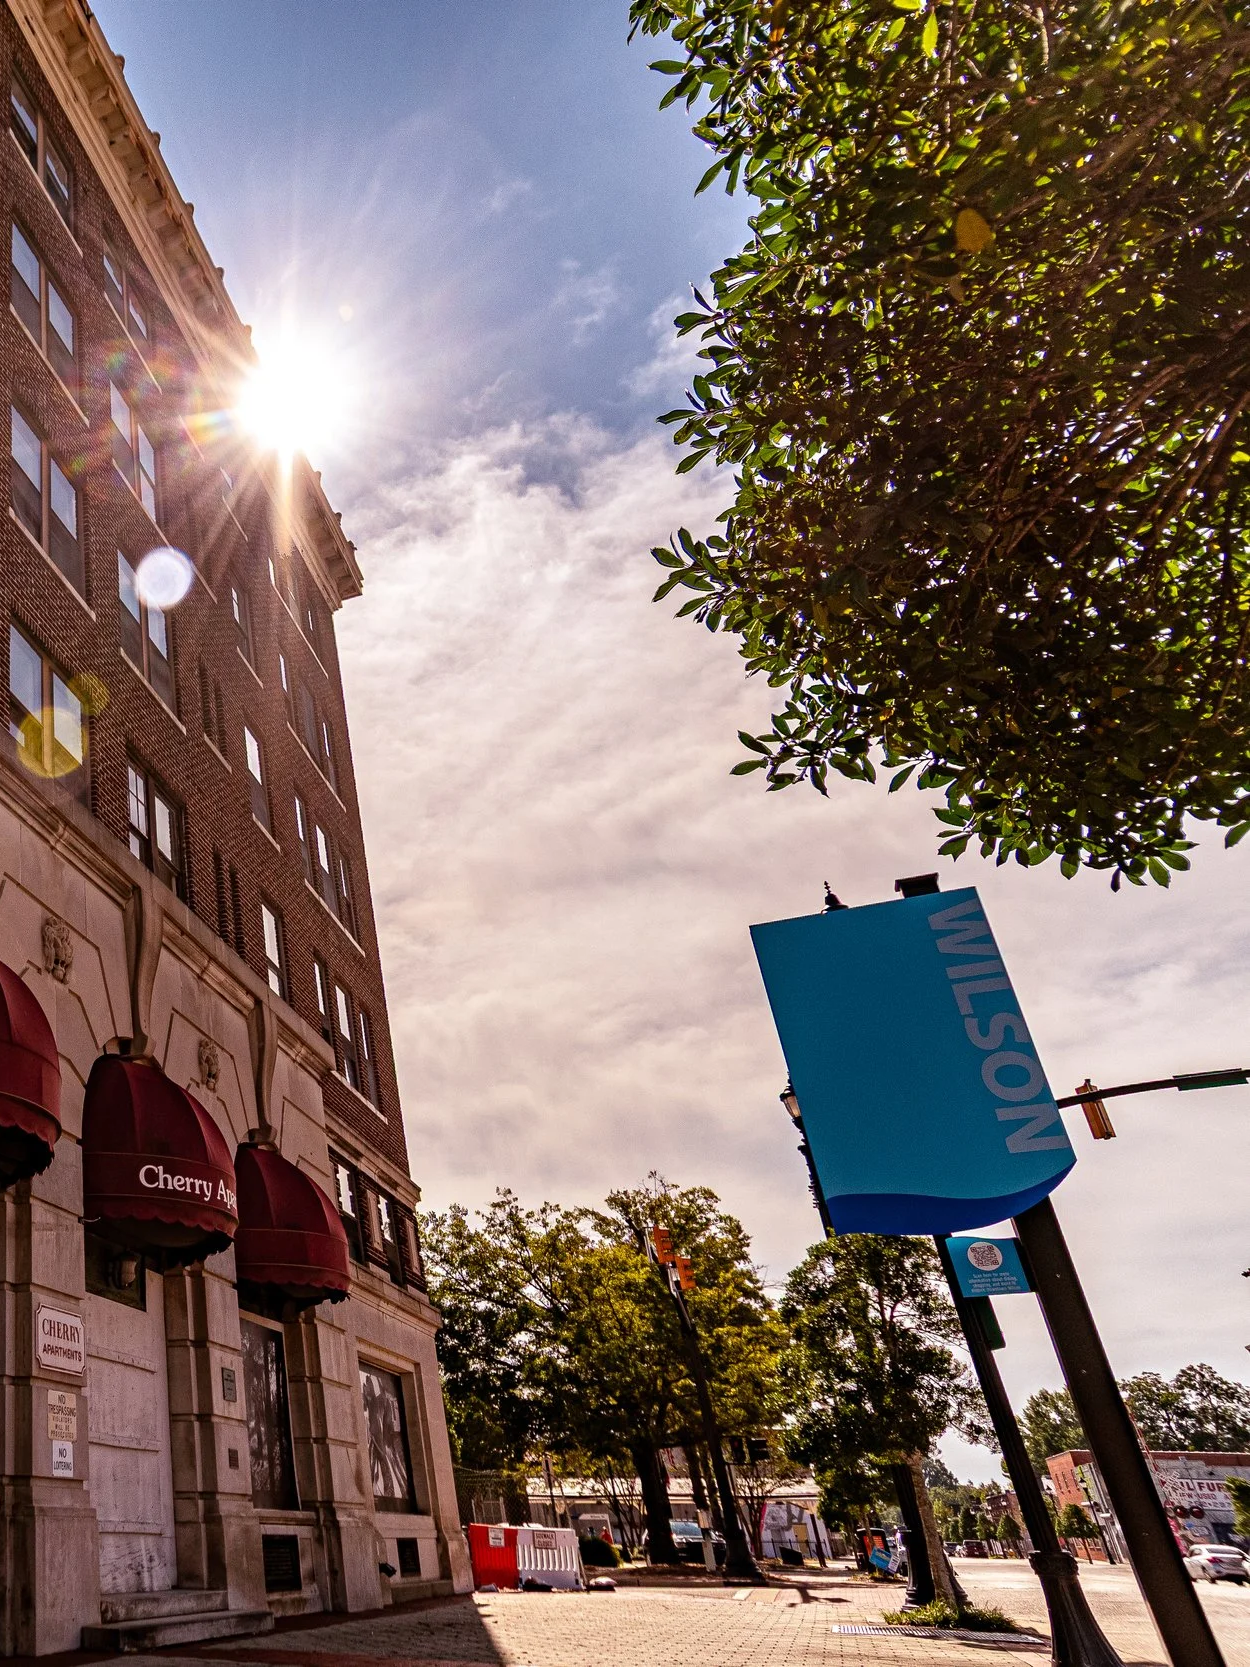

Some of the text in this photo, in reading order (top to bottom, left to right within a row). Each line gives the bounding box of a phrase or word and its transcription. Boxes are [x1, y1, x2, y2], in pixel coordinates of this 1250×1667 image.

[928, 900, 1072, 1153] WILSON
[139, 1165, 212, 1201] Cherry
[42, 1318, 81, 1344] CHERRY
[42, 1343, 82, 1362] APARTMENTS
[58, 1394, 66, 1404] NO
[48, 1403, 76, 1417] TRESPASSING
[58, 1447, 67, 1459] NO
[53, 1461, 72, 1472] LOITERING
